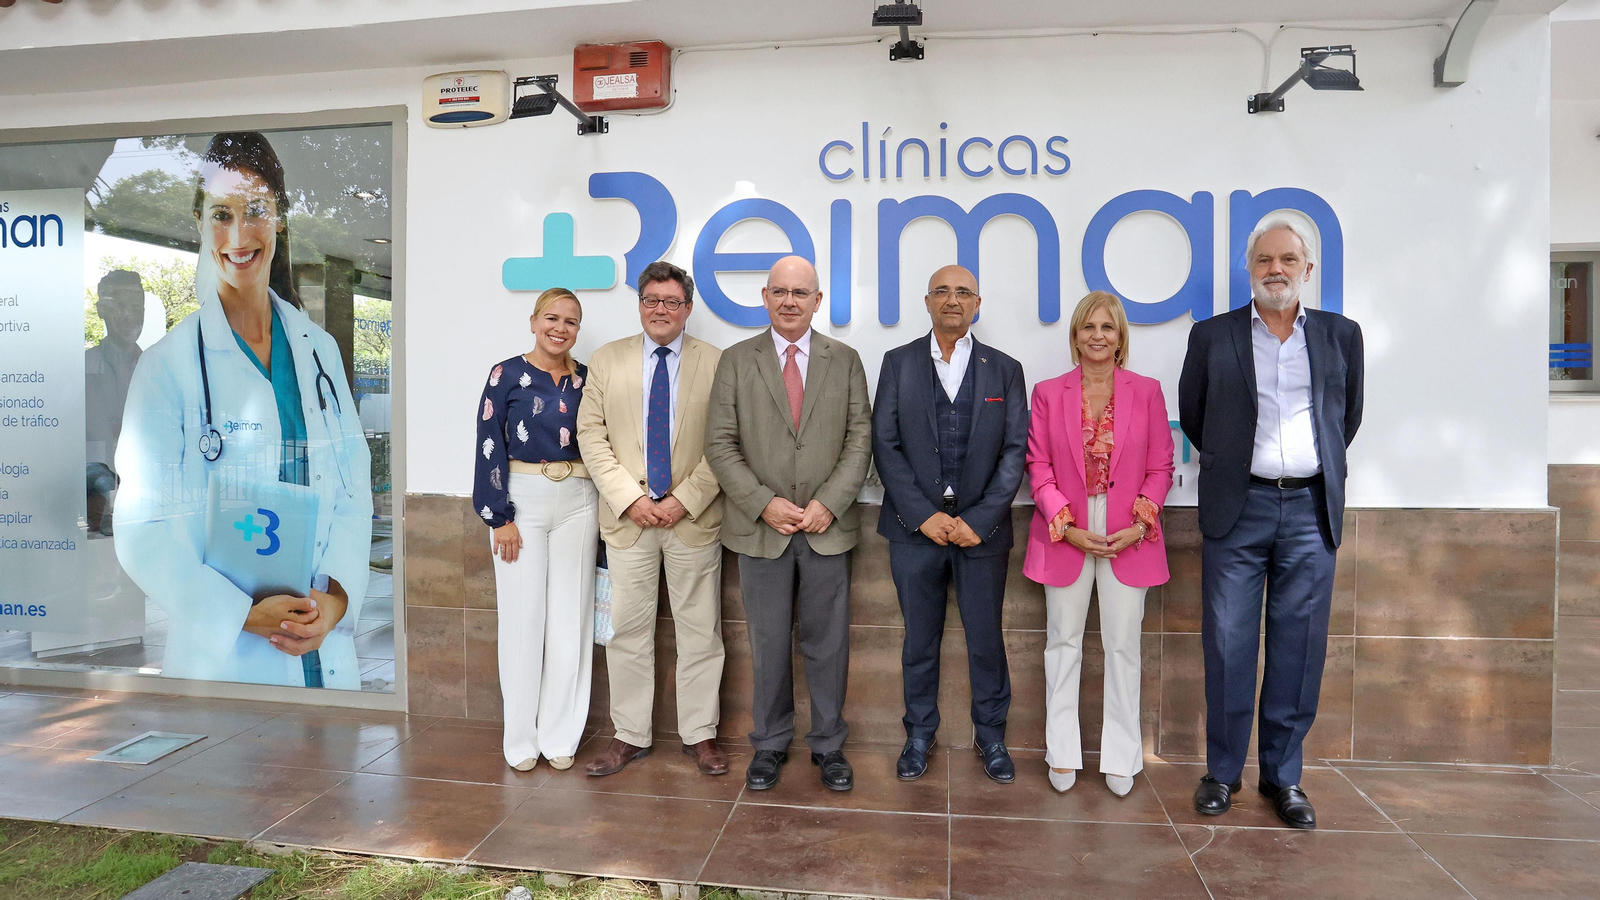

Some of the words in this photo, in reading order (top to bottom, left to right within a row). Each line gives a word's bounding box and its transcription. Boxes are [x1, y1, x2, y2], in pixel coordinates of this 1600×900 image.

[605, 75, 635, 85] JEALSA
[440, 85, 478, 94] PROTELEC
[819, 121, 1071, 180] clínicas
[0, 201, 9, 213] s
[0, 213, 63, 248] an
[1550, 277, 1578, 289] an
[1, 370, 45, 383] anzada
[2, 414, 18, 427] de
[21, 414, 59, 427] tráfico
[0, 462, 29, 478] logía
[0, 511, 32, 526] apilar
[20, 538, 76, 551] avanzada
[0, 603, 46, 617] an.es
